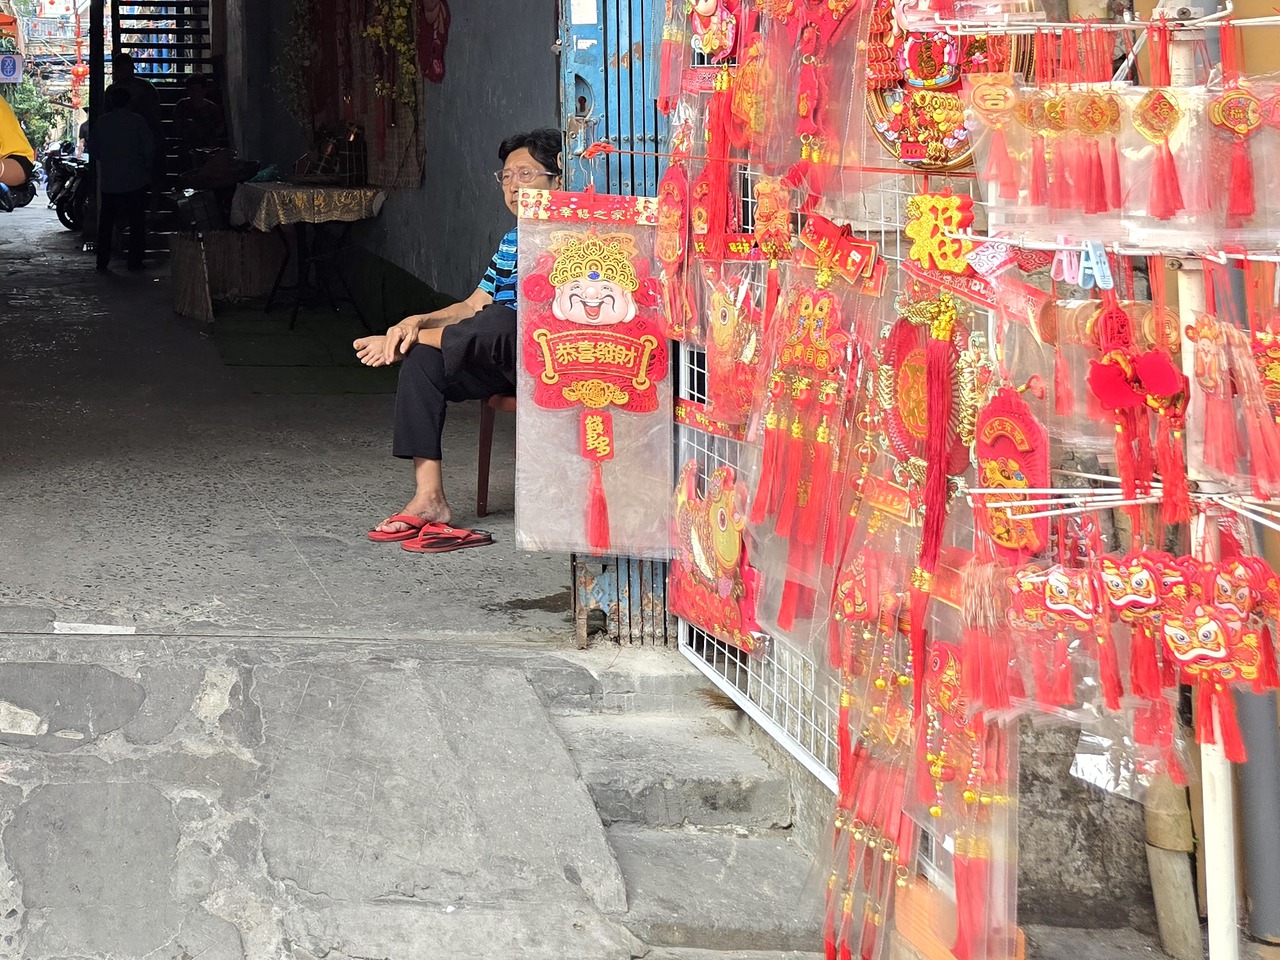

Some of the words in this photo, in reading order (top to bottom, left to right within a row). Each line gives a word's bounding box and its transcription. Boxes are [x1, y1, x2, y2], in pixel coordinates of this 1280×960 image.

[981, 85, 1006, 110] 吉
[906, 192, 973, 274] 福
[555, 340, 638, 368] 恭喜發財
